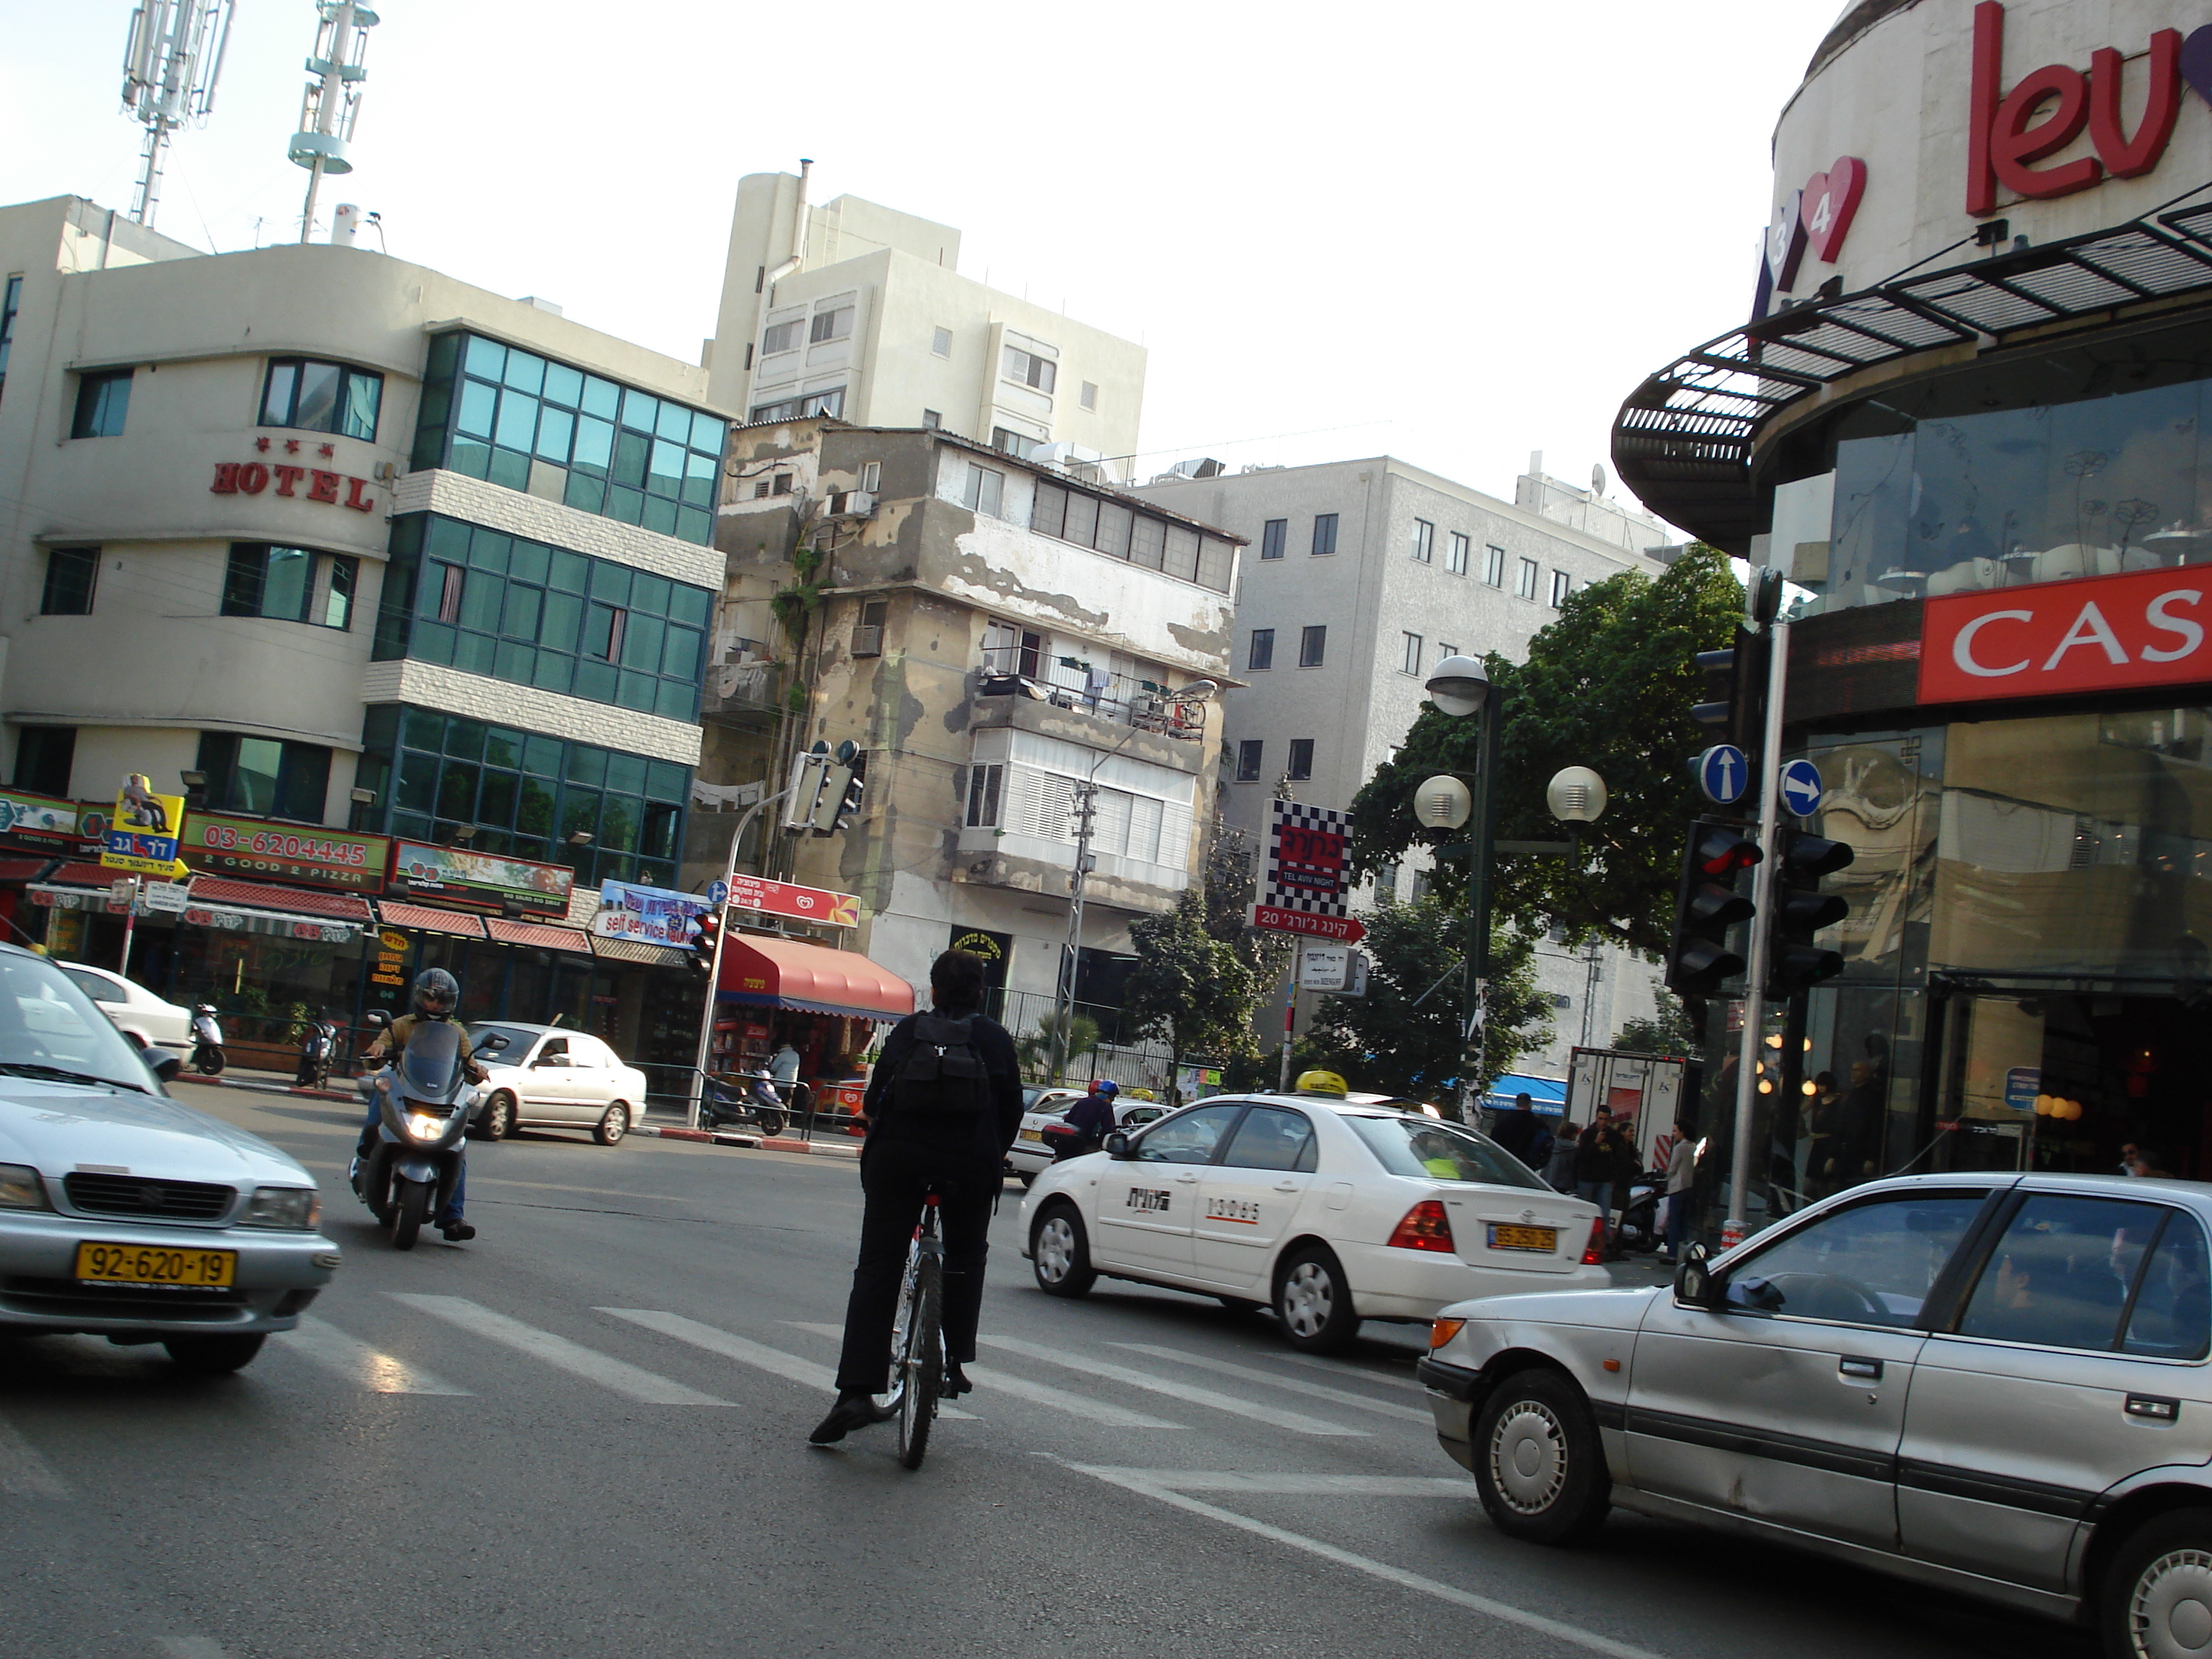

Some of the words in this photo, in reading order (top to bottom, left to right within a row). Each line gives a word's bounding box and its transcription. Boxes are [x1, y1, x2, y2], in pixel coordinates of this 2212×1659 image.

[1810, 192, 1831, 234] 4
[1773, 222, 1786, 266] 3
[210, 462, 374, 513] HOTEL
[1952, 590, 2203, 677] CAS
[112, 836, 131, 853] גב
[204, 825, 367, 866] 03-6204445
[204, 854, 213, 863] 2
[224, 857, 281, 872] GOOD
[291, 866, 300, 875] 2
[310, 868, 361, 882] PIZZA
[1284, 871, 1296, 881] TEL
[1297, 875, 1313, 884] AVIV
[1313, 877, 1335, 887] NIGHT
[606, 914, 626, 931] self
[627, 920, 665, 940] service
[667, 929, 698, 945] laund
[1261, 911, 1279, 925] 20
[1321, 921, 1349, 938] קינג
[90, 1247, 223, 1282] 92-620-19
